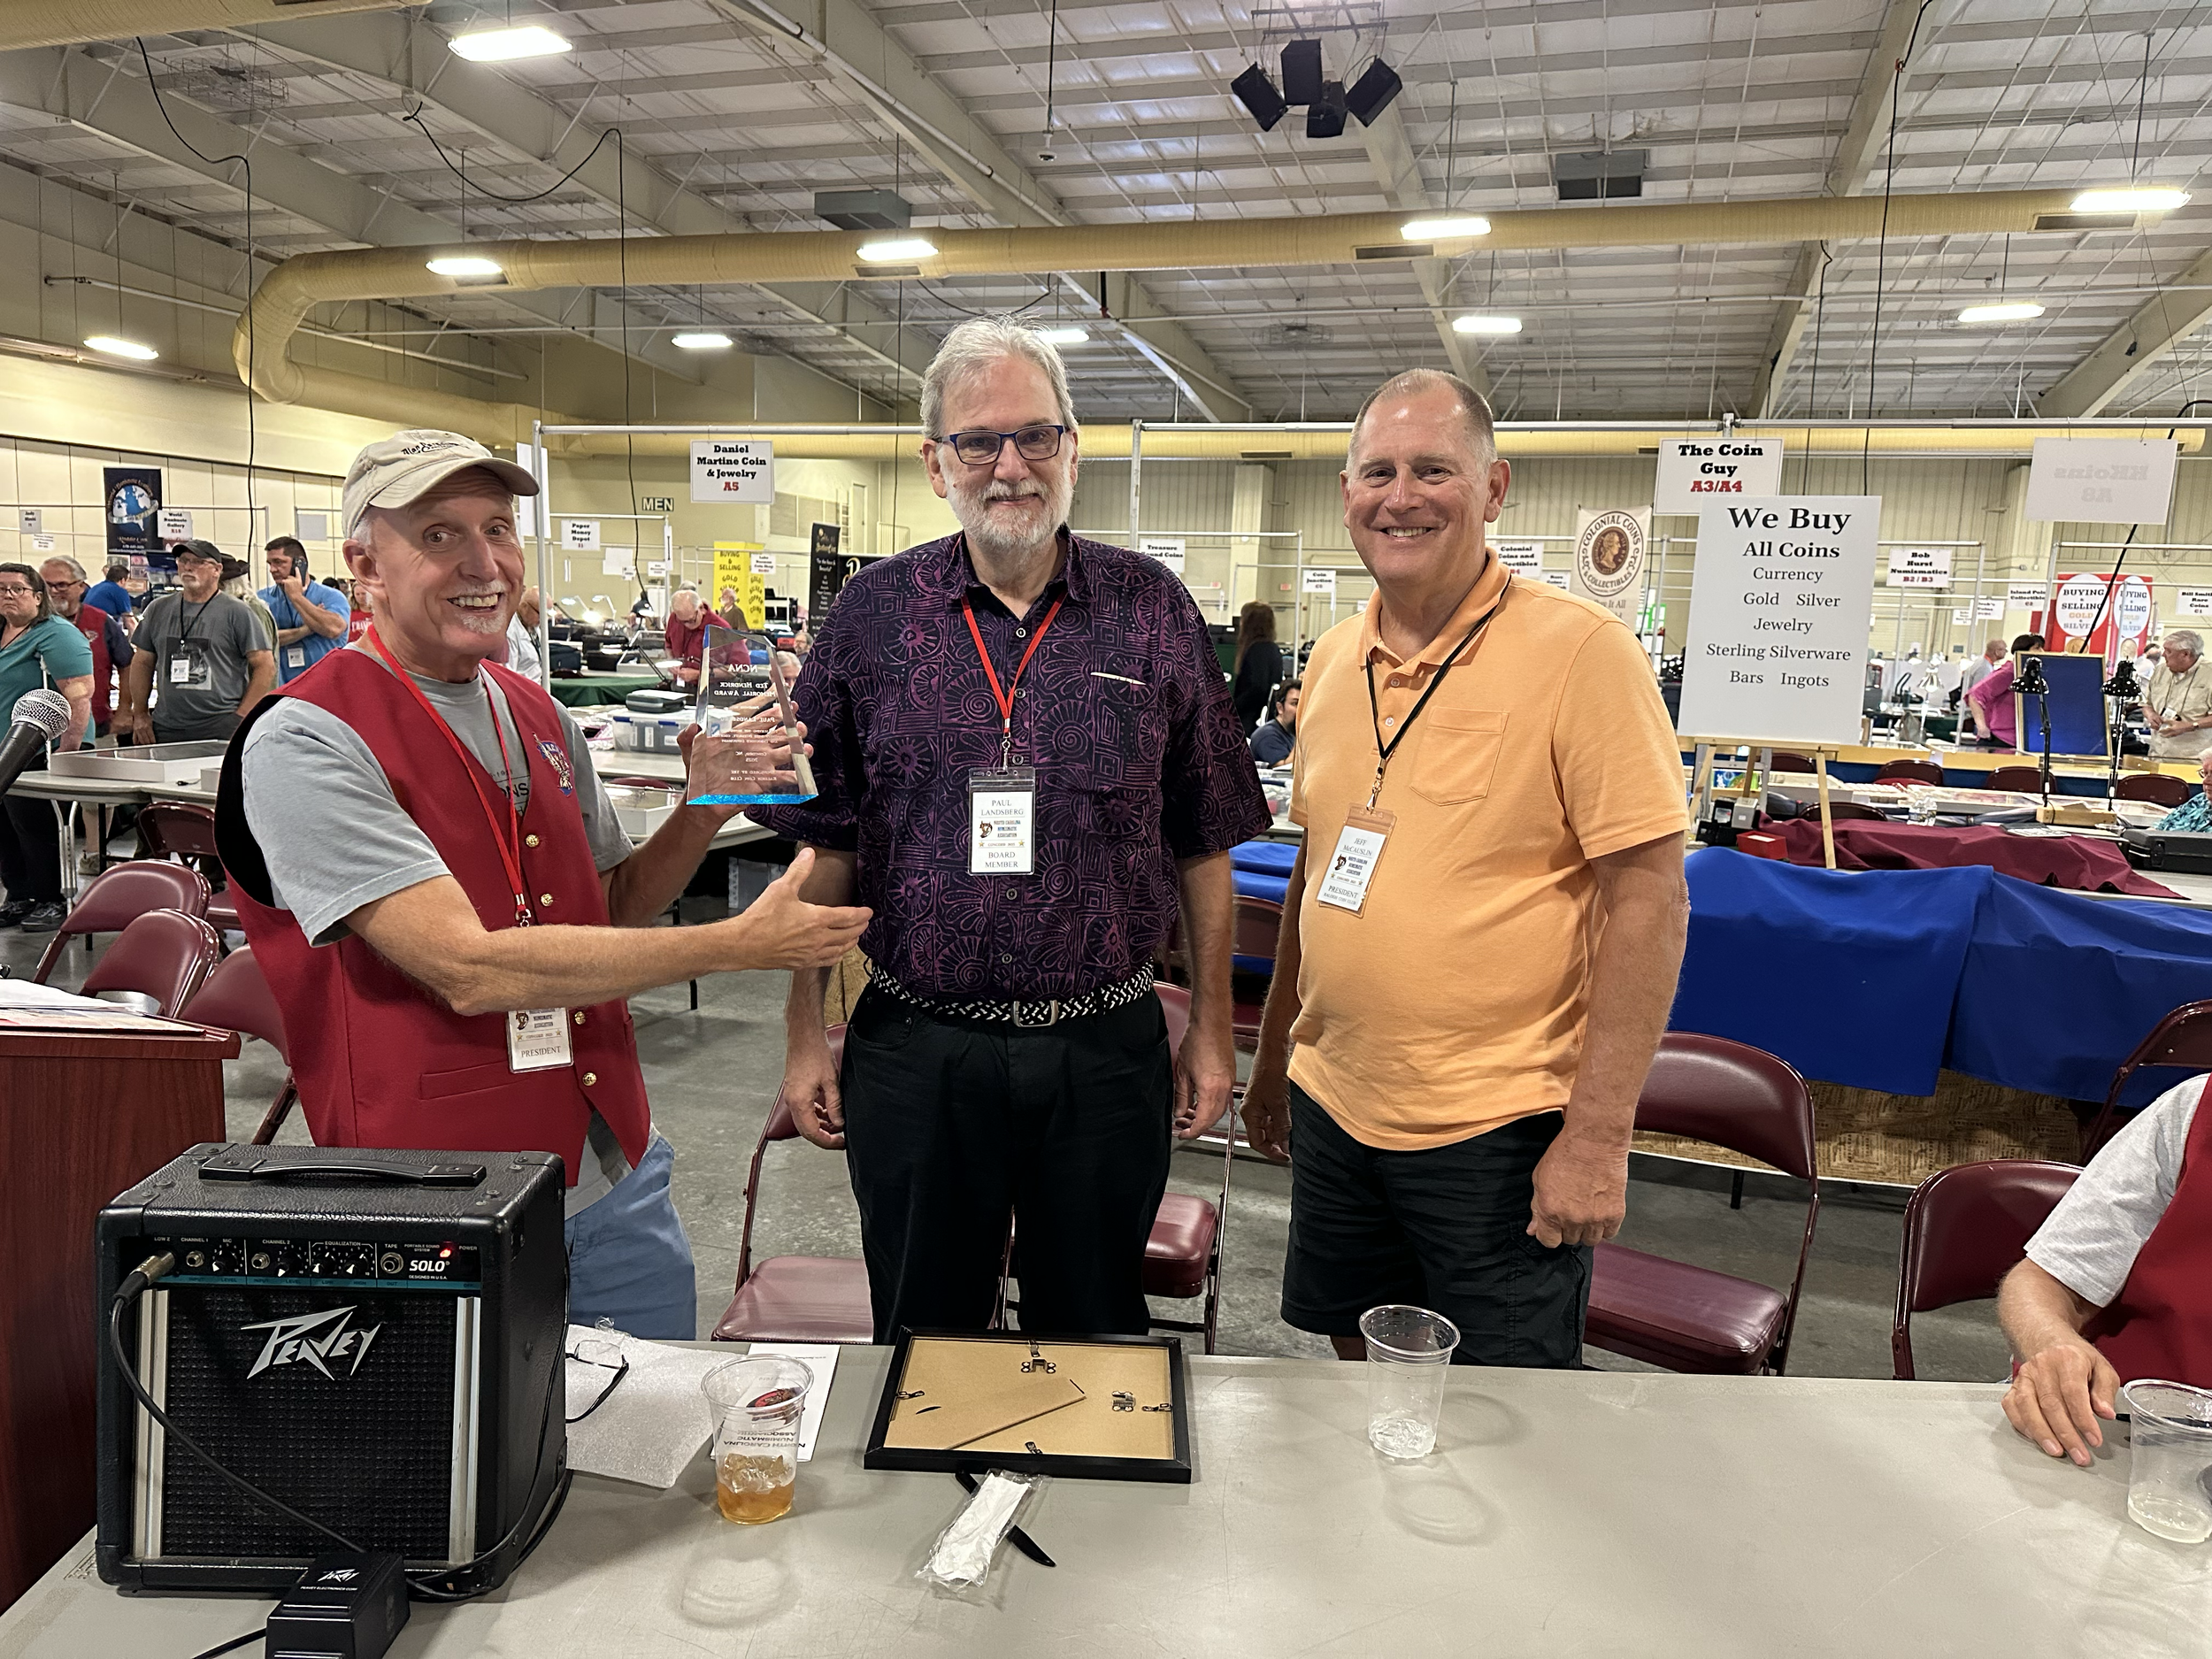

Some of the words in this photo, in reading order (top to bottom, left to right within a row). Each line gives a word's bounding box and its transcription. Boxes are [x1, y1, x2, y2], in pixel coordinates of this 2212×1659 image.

[1678, 444, 1714, 457] The
[1717, 444, 1763, 457] Coin
[696, 457, 739, 465] Martine
[716, 469, 757, 480] Jewelry
[1700, 463, 1738, 478] Guy
[723, 481, 739, 491] A5
[1690, 480, 1743, 493] A3/A4
[642, 498, 673, 511] MEN
[1727, 507, 1779, 529] We
[1788, 507, 1852, 535] Buy
[1583, 515, 1621, 547] COLONIAL
[1622, 518, 1641, 545] COINS
[1743, 541, 1773, 557] All
[1778, 542, 1840, 558] Coins
[1587, 572, 1632, 588] COLLECTIBLES
[1753, 567, 1824, 584] Currency
[1615, 600, 1626, 609] All
[1743, 592, 1779, 606] Gold
[1795, 594, 1841, 608] Silver
[1753, 618, 1813, 635] Jewelry
[1706, 643, 1766, 660] Sterling
[1769, 644, 1852, 661] Silverware
[1730, 670, 1764, 684] Bars
[1780, 672, 1830, 689] Ingots
[1328, 886, 1359, 899] PRESIDENT
[521, 1046, 562, 1058] PRESIDENT
[409, 1260, 445, 1272] SOLO
[241, 1305, 385, 1380] PEAVEY
